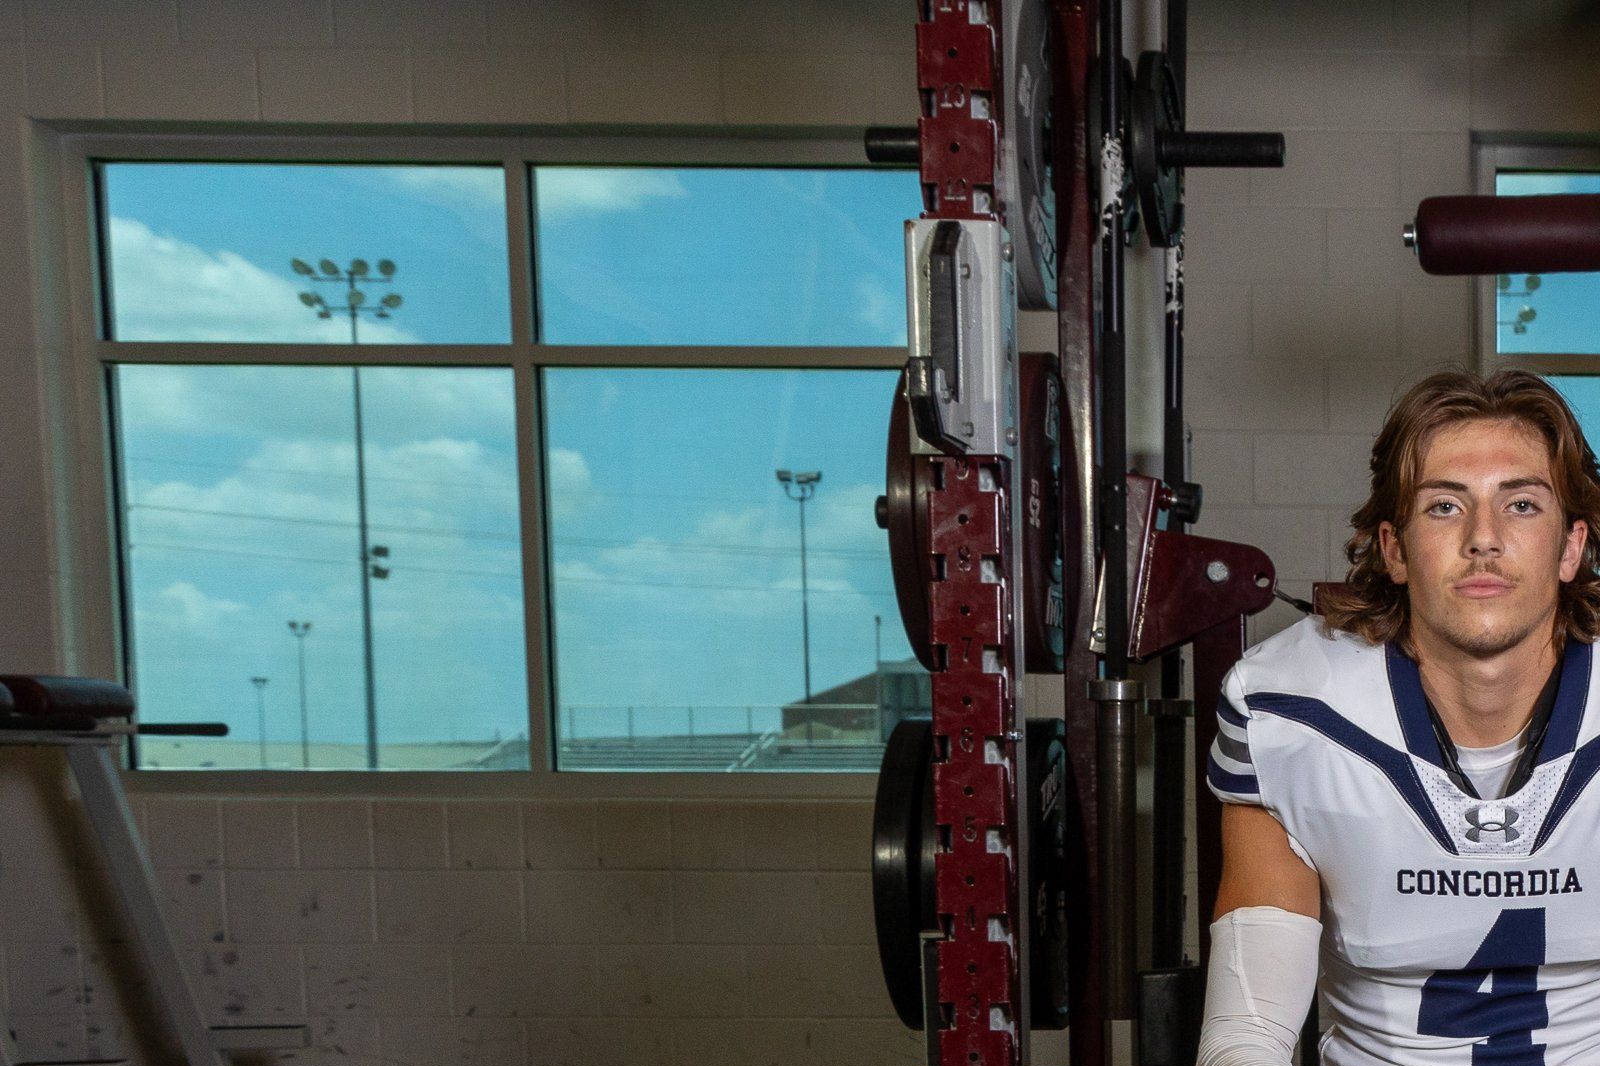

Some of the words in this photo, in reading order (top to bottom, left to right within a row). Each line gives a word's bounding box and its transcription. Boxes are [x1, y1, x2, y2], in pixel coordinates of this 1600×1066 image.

[941, 82, 965, 108] 13
[961, 637, 973, 663] 7
[960, 727, 974, 753] 6
[961, 817, 977, 842] 5
[1397, 868, 1582, 897] CONCORDIA
